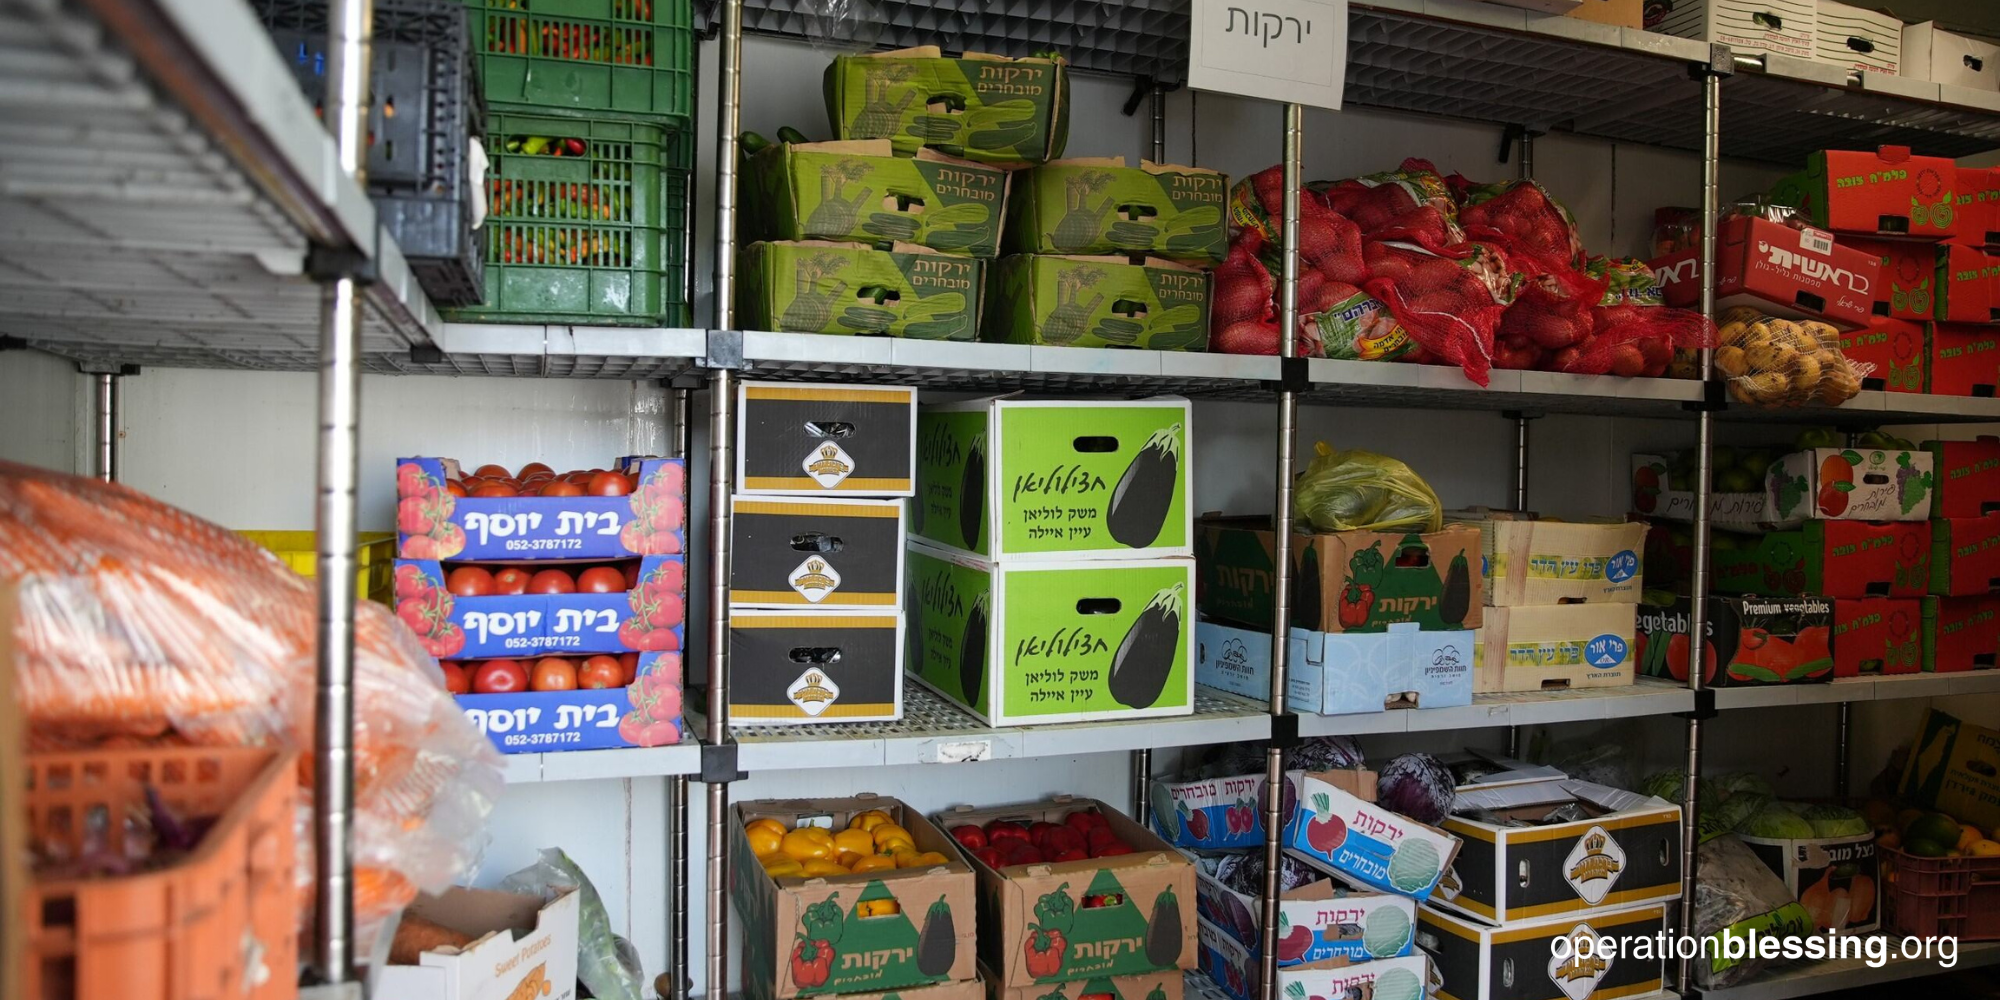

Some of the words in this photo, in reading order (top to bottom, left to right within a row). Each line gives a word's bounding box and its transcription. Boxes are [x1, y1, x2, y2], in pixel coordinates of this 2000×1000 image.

[1225, 7, 1310, 48] ירקות
[980, 65, 1042, 82] ירקות
[977, 80, 1042, 96] מובחרים
[937, 167, 995, 187] ירקות
[1173, 174, 1222, 192] ירקות
[936, 182, 995, 201] מובחרים
[1172, 186, 1223, 203] מובחרים
[914, 259, 970, 277] ירקות
[912, 273, 971, 290] מובחרים
[1160, 273, 1204, 290] ירקות
[1158, 286, 1204, 302] מובחרים
[1023, 503, 1063, 521] לוליאן
[1068, 507, 1097, 521] משק
[463, 511, 543, 546] יוסף
[554, 510, 622, 536] בית
[1028, 525, 1063, 540] איילה
[1069, 526, 1092, 541] עיין
[505, 538, 582, 550] 052-3787172
[1378, 596, 1438, 615] ירקות
[1742, 601, 1782, 615] Premium
[463, 610, 542, 645] יוסף
[553, 608, 621, 634] בית
[505, 636, 581, 648] 052-3787172
[1590, 640, 1606, 654] אור
[1609, 640, 1624, 653] פרי
[1025, 667, 1065, 687] לוליאן
[1070, 669, 1099, 682] משק
[1030, 689, 1065, 703] איילה
[1070, 689, 1093, 704] עיין
[464, 706, 542, 737] יוסף
[553, 703, 621, 729] בית
[504, 732, 581, 746] 052-3787172
[1170, 783, 1217, 800] מובחרים
[1225, 778, 1255, 797] ירקות
[1353, 809, 1404, 840] ירקות
[1338, 848, 1387, 880] מובחרים
[1315, 908, 1365, 926] ירקות
[494, 952, 519, 978] Sweet
[521, 933, 552, 962] Potatoes
[1074, 936, 1143, 960] ירקות
[841, 946, 913, 970] ירקות
